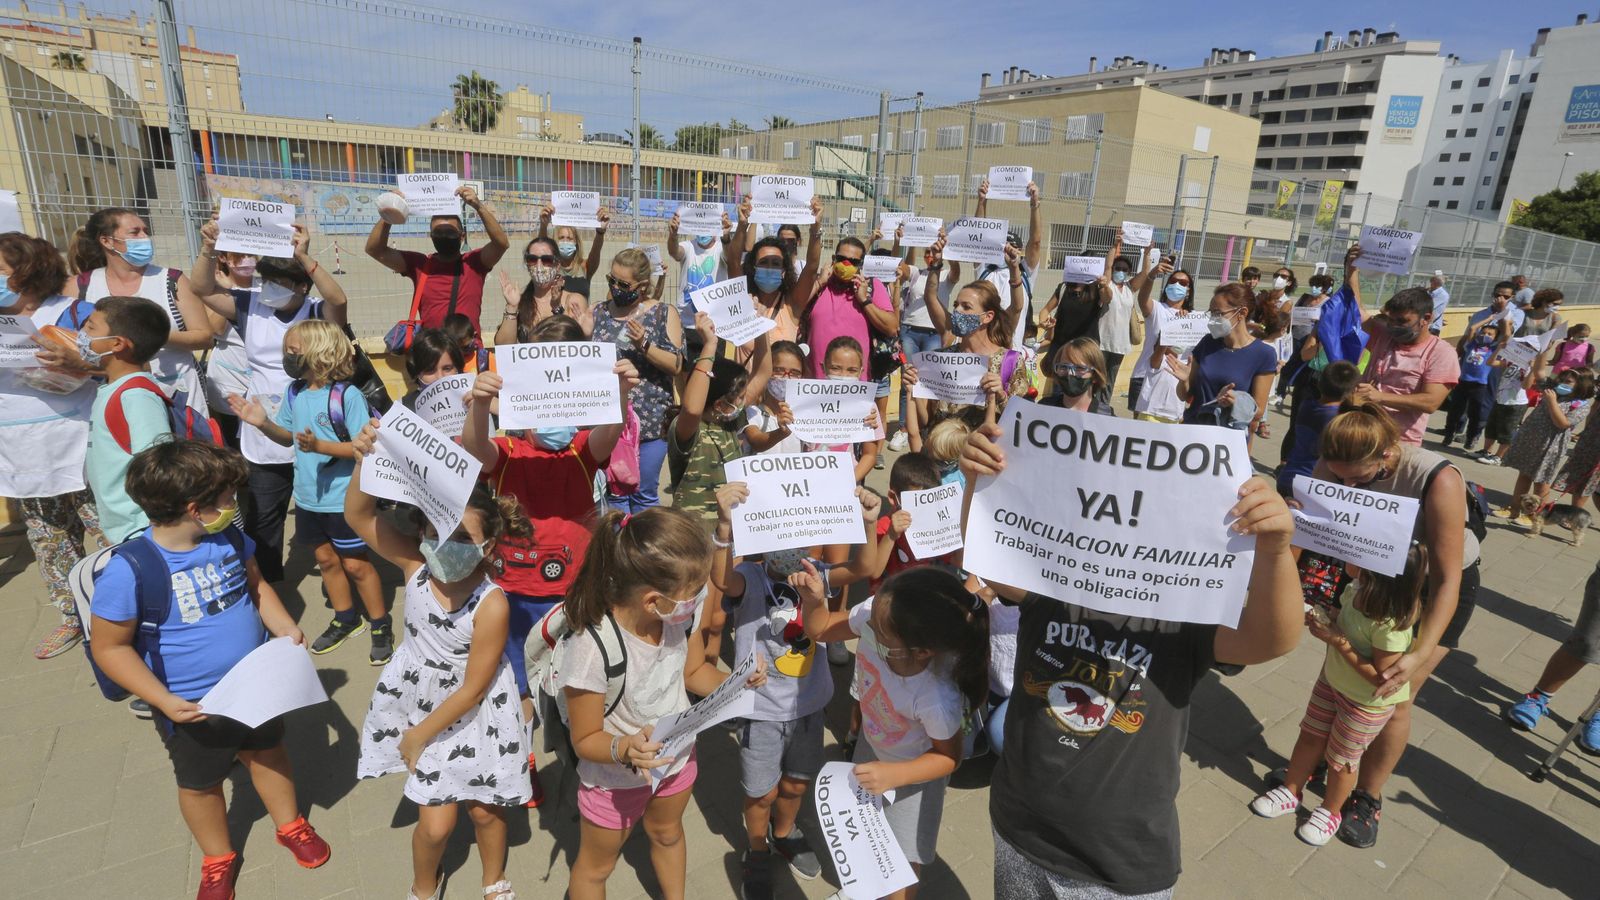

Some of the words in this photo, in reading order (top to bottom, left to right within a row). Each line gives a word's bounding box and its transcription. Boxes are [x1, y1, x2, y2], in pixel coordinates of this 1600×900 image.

[1388, 116, 1416, 125] PISOS
[406, 174, 450, 184] ¡COMEDOR
[758, 176, 806, 186] ¡COMEDOR
[422, 186, 436, 194] YA!
[775, 190, 789, 199] YA!
[228, 200, 283, 214] ¡COMEDOR
[244, 217, 262, 228] YA!
[953, 218, 1002, 230] ¡COMEDOR
[968, 233, 982, 242] YA!
[1369, 227, 1413, 239] ¡COMEDOR
[1378, 242, 1392, 250] YA!
[728, 300, 742, 316] YA!
[512, 345, 602, 363] ¡COMEDOR
[921, 353, 980, 365] ¡COMEDOR
[544, 366, 570, 383] YA!
[941, 370, 957, 380] YA!
[797, 382, 868, 395] ¡COMEDOR
[920, 377, 956, 389] CONCILIACION
[416, 378, 468, 410] COMEDOR
[510, 392, 570, 403] CONCILIACION
[572, 390, 611, 398] FAMILIAR
[430, 397, 451, 413] YA!
[513, 404, 540, 412] Trabajar
[577, 400, 600, 409] opción
[820, 400, 840, 413] YA!
[552, 410, 587, 419] obligación
[387, 412, 469, 478] ¡COMEDOR
[1012, 411, 1234, 478] ¡COMEDOR
[406, 456, 428, 484] YA!
[742, 455, 838, 477] ¡COMEDOR
[375, 470, 408, 485] Trabajar
[781, 479, 810, 498] YA!
[914, 486, 958, 507] ¡COMEDOR
[1308, 480, 1400, 514] ¡COMEDOR
[744, 507, 812, 522] CONCILIACION
[814, 505, 853, 514] FAMILIAR
[937, 506, 950, 521] YA!
[1076, 487, 1144, 528] YA!
[748, 523, 781, 533] Trabajar
[821, 516, 845, 526] opción
[1333, 510, 1360, 527] YA!
[794, 527, 832, 538] obligación
[912, 526, 950, 538] CONCILIACION
[993, 508, 1128, 558] CONCILIACION
[1132, 545, 1236, 569] FAMILIAR
[1295, 515, 1351, 540] CONCILIACION
[1352, 535, 1394, 552] FAMILIAR
[1295, 525, 1321, 538] Trabajar
[1355, 544, 1378, 556] opción
[1327, 542, 1362, 559] obligación
[993, 530, 1053, 560] Trabajar
[1057, 555, 1077, 569] no
[1082, 560, 1100, 574] es
[1105, 566, 1137, 582] una
[1142, 570, 1200, 588] opción
[1205, 577, 1224, 590] es
[1040, 568, 1068, 586] una
[1073, 577, 1160, 603] obligación
[1045, 621, 1097, 655] PUR
[818, 774, 857, 886] ¡COMEDOR
[838, 808, 859, 841] YA!
[858, 808, 889, 879] CONCILIACION
[881, 829, 890, 844] una
